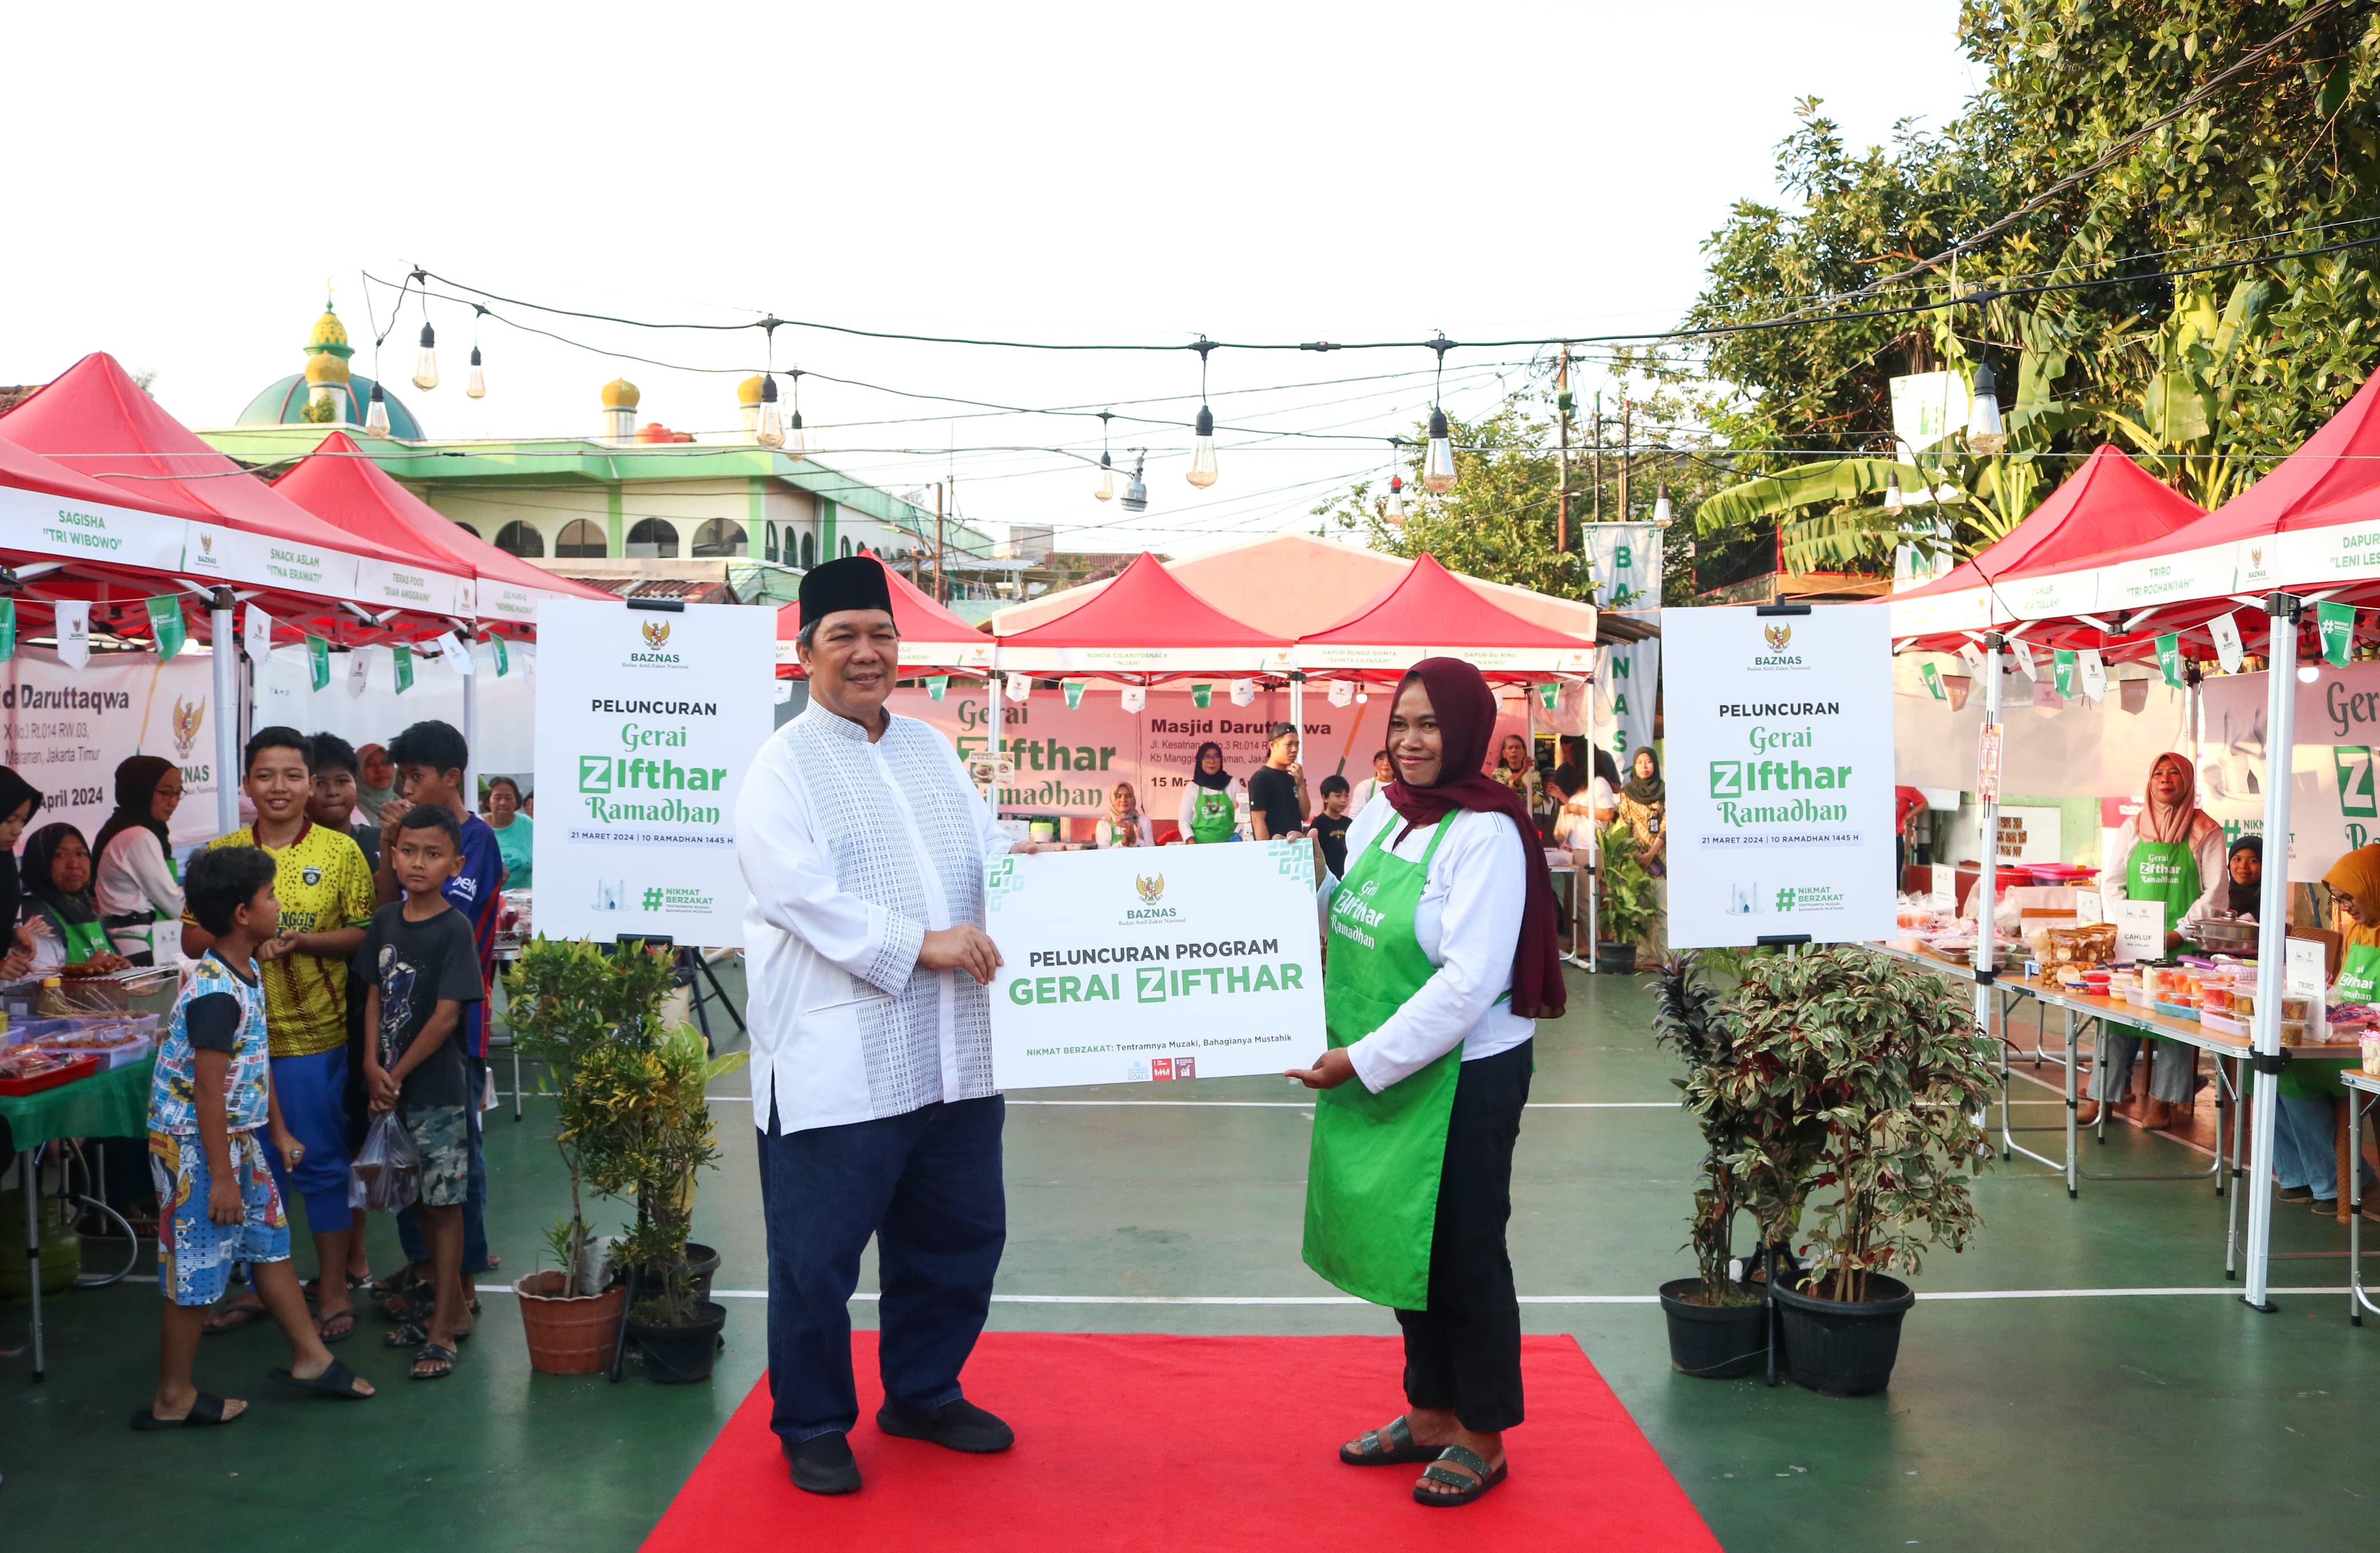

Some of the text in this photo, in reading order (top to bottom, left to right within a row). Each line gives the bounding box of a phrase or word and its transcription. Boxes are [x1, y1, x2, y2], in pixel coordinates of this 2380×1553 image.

[59, 510, 105, 529] SAGISHA
[43, 528, 122, 550] "TRI WIBOWO"
[271, 548, 320, 568] SNACK ASLAM
[2330, 554, 2360, 569] "LENI
[2149, 566, 2171, 579] TRIRO
[2248, 570, 2266, 579] BAZNAS
[2127, 578, 2194, 597] "TRI ROCHANIYAH"
[631, 653, 680, 663] BAZNAS
[1755, 656, 1802, 665] BAZNAS
[21, 684, 129, 715] Daruttaqwa
[592, 699, 717, 716] PELUNCURAN
[1719, 702, 1839, 717] PELUNCURAN
[1151, 719, 1212, 736] Masjid
[621, 723, 687, 752] Gerai
[1151, 741, 1160, 749] Jl.
[1233, 740, 1259, 750] Rt.014
[1750, 726, 1812, 755] Gerai
[46, 746, 75, 763] Jakarta
[78, 746, 101, 761] Timur
[1151, 777, 1167, 787] 15
[72, 786, 104, 806] 2024
[585, 796, 720, 825] Ramadhan
[1717, 799, 1847, 827] Ramadhan
[654, 835, 703, 843] RAMADHAN
[2148, 854, 2169, 863] Gerai
[2141, 875, 2179, 884] Ramadhan
[666, 896, 713, 904] BERZAKAT
[1127, 908, 1176, 919] BAZNAS
[1331, 914, 1375, 950] Ramadhan
[1030, 938, 1278, 967] PELUNCURAN PROGRAM
[1009, 973, 1120, 1006] GERAI
[2298, 981, 2314, 991] TRIRO
[1026, 1034, 1292, 1056] NIKMAT BERZAKAT: Tentramnya Muzaki, Bahagianya Mustahik
